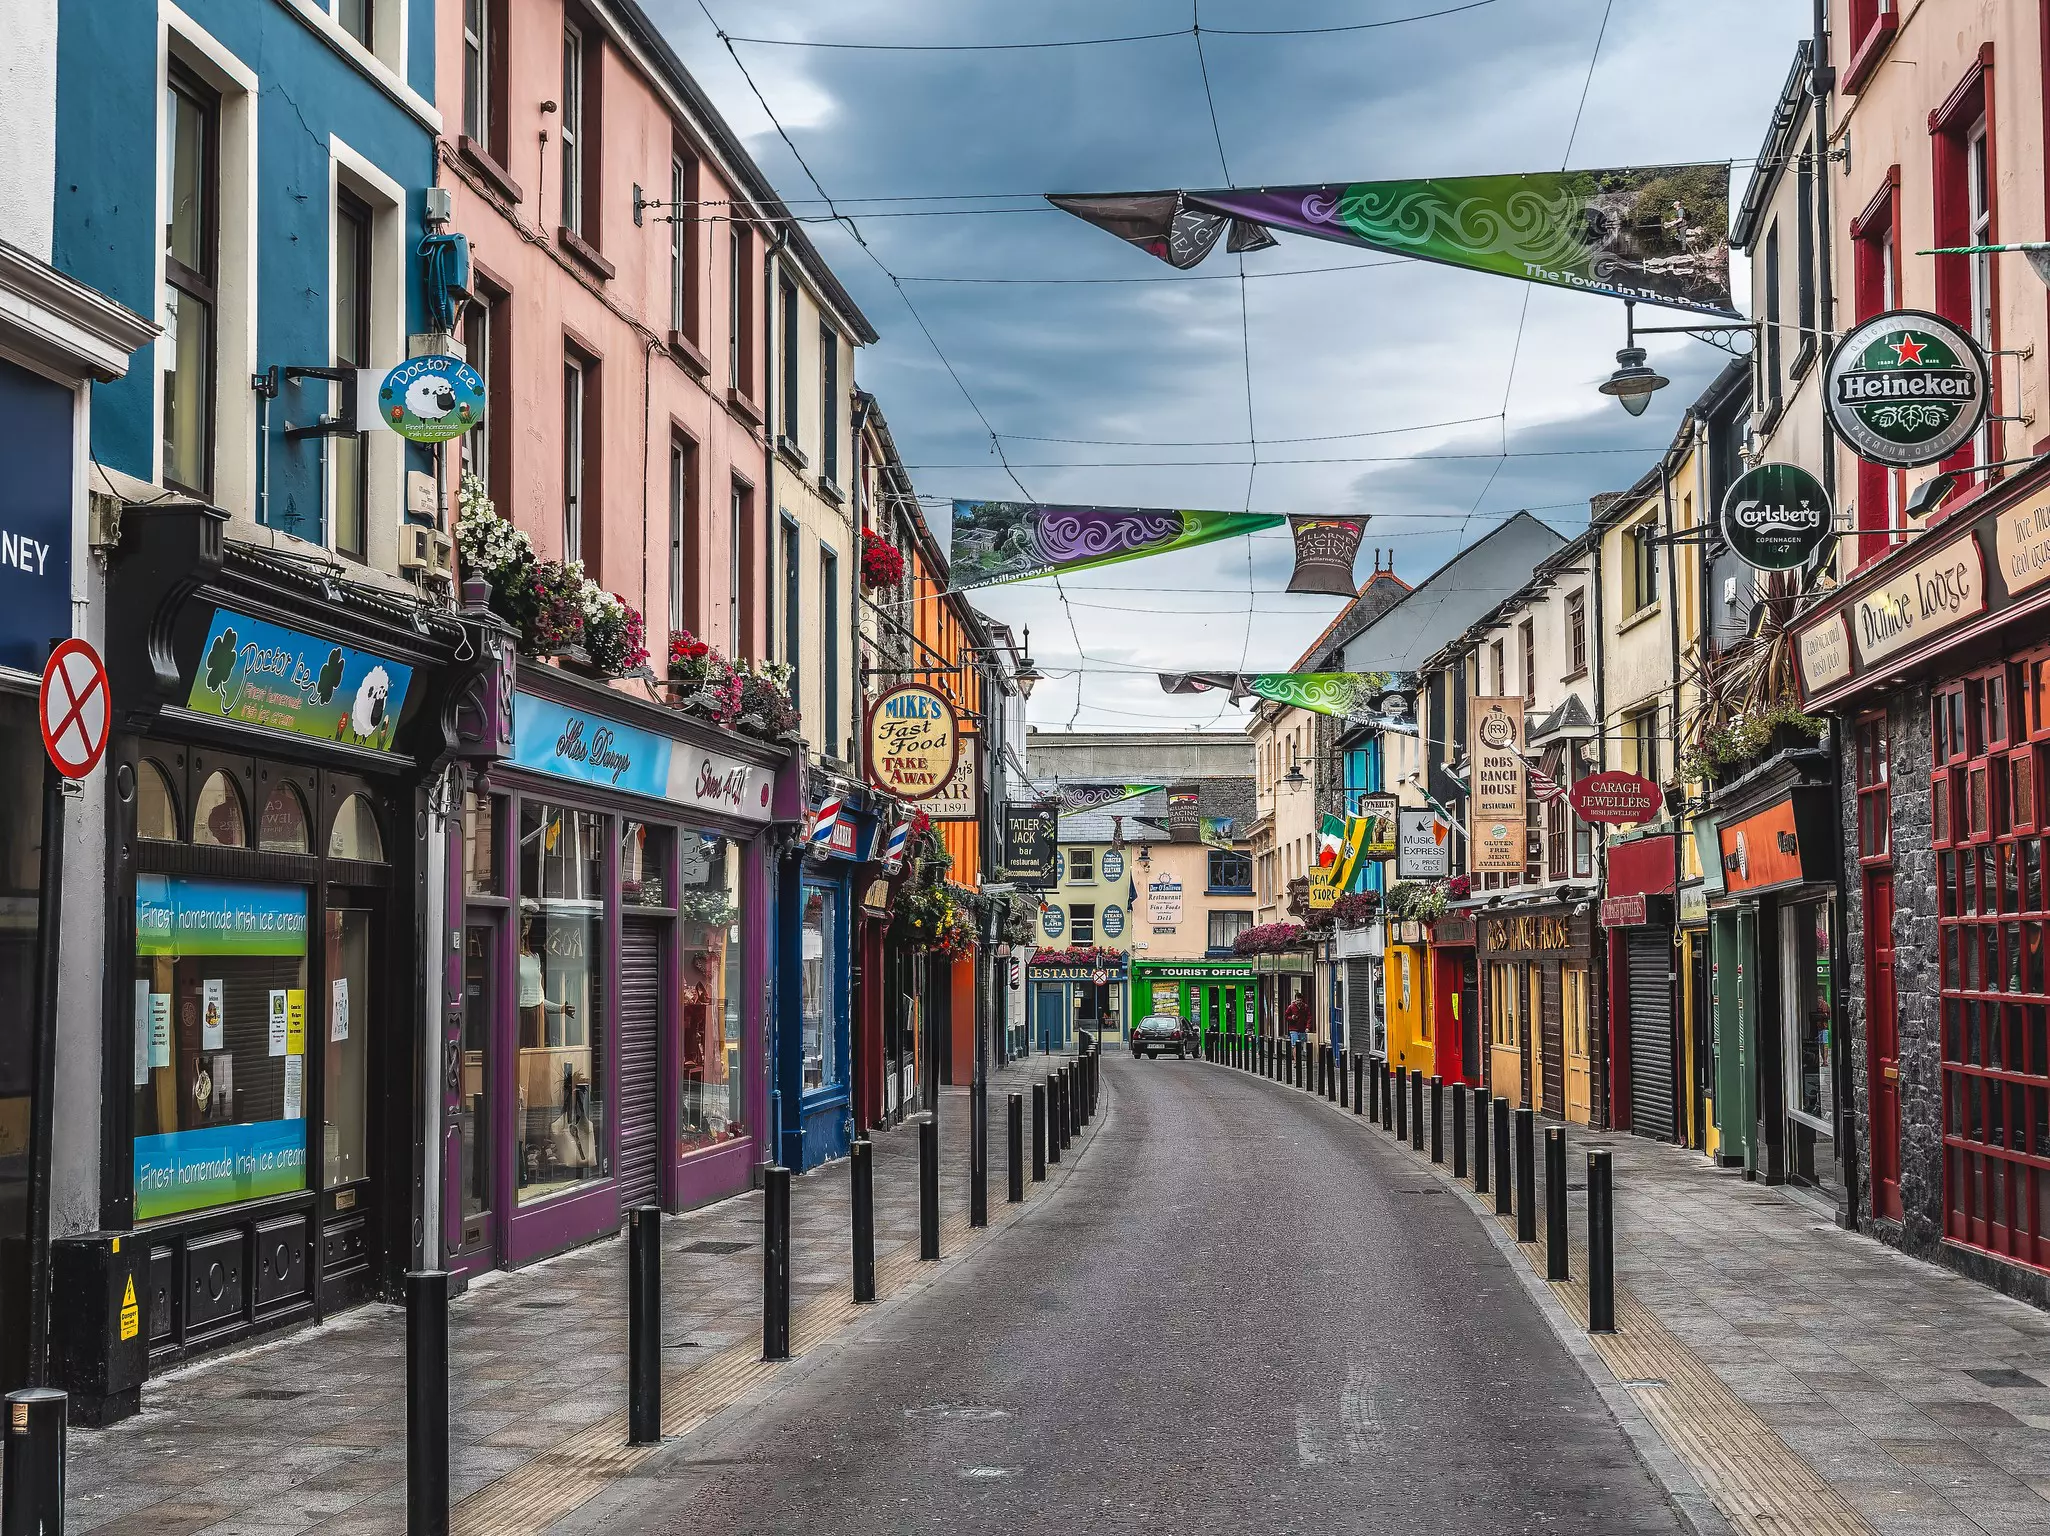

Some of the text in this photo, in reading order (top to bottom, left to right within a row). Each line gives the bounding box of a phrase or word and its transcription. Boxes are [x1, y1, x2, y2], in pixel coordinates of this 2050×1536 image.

[1524, 262, 1559, 281] The
[1562, 271, 1614, 292] Town
[1618, 283, 1636, 296] in
[1677, 296, 1722, 310] Park
[389, 358, 477, 391] Doctor Ice
[1844, 373, 1971, 399] Heineken
[426, 423, 459, 431] homemade
[1914, 423, 1964, 456] QUALITY
[1735, 500, 1821, 530] Carlsberg
[2, 530, 50, 576] NEY
[957, 564, 1055, 590] www.killarney.ie
[1861, 562, 1970, 649] Dunloe Lodge
[240, 642, 311, 686] Doctor Ice
[885, 695, 942, 719] MIKE'S
[1331, 710, 1345, 719] The
[1347, 714, 1368, 726] Town
[878, 720, 932, 739] Fast
[556, 717, 588, 762] Miss
[888, 733, 947, 755] Food
[882, 757, 928, 772] TAKE
[1483, 757, 1513, 768] ROBS
[890, 769, 938, 785] AWAY
[1480, 771, 1517, 781] RANCH
[933, 783, 970, 800] AR
[1481, 784, 1517, 795] HOUSE
[1591, 782, 1641, 793] CARAGH
[1581, 796, 1650, 808] JEWELLERS
[1009, 819, 1039, 830] TATLER
[1012, 832, 1035, 843] JACK
[1019, 847, 1032, 855] bar
[1404, 847, 1445, 855] EXPRESS
[1010, 858, 1039, 866] restaurant
[1313, 888, 1337, 900] STORE
[141, 897, 306, 932] Finest homemade Irish ice cream
[1160, 968, 1251, 976] TOURIST OFFICE
[140, 1146, 306, 1191] Finest homemade Irish ice cream
[122, 1311, 137, 1320] Danger
